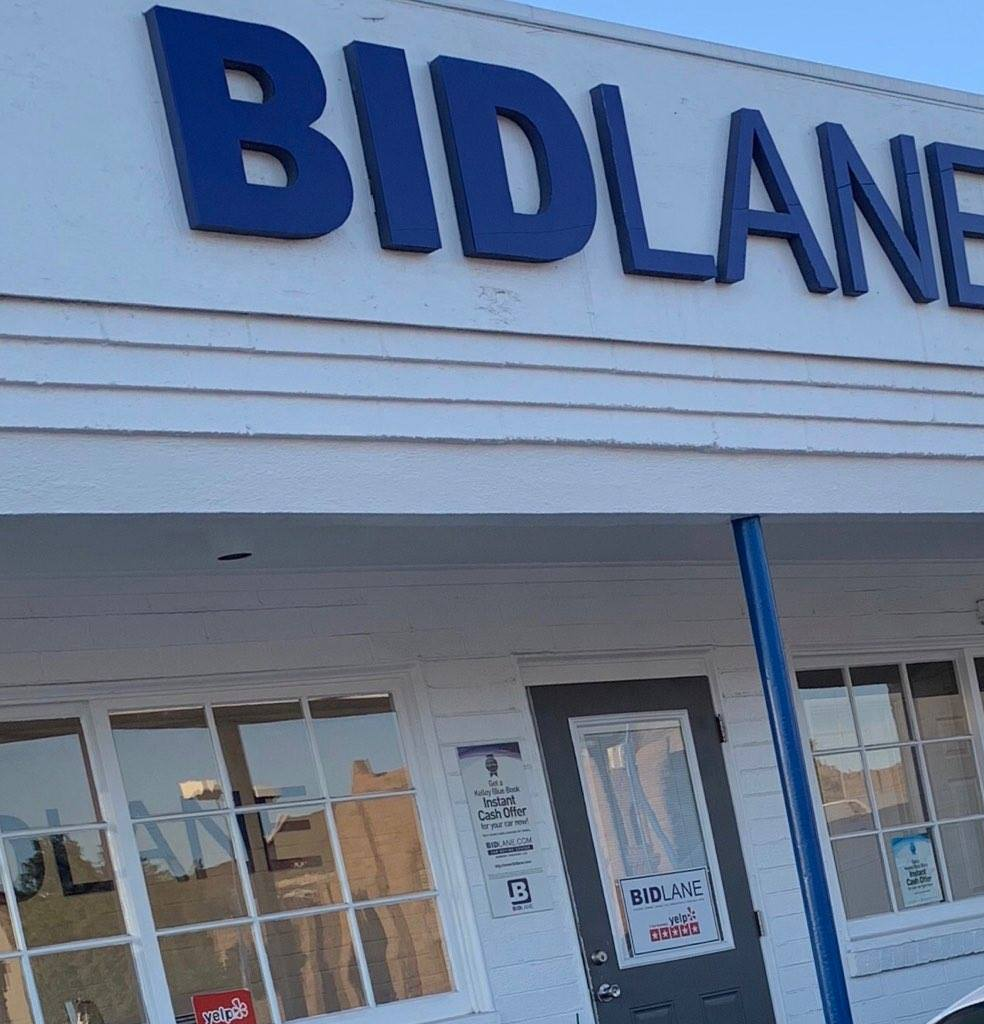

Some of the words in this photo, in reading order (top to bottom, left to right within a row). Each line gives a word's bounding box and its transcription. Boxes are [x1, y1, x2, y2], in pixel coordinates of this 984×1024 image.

[482, 795, 516, 808] Instant
[478, 809, 502, 821] Cash
[503, 806, 527, 818] Offer
[630, 880, 704, 906] BIDLANE
[669, 912, 688, 926] yelp
